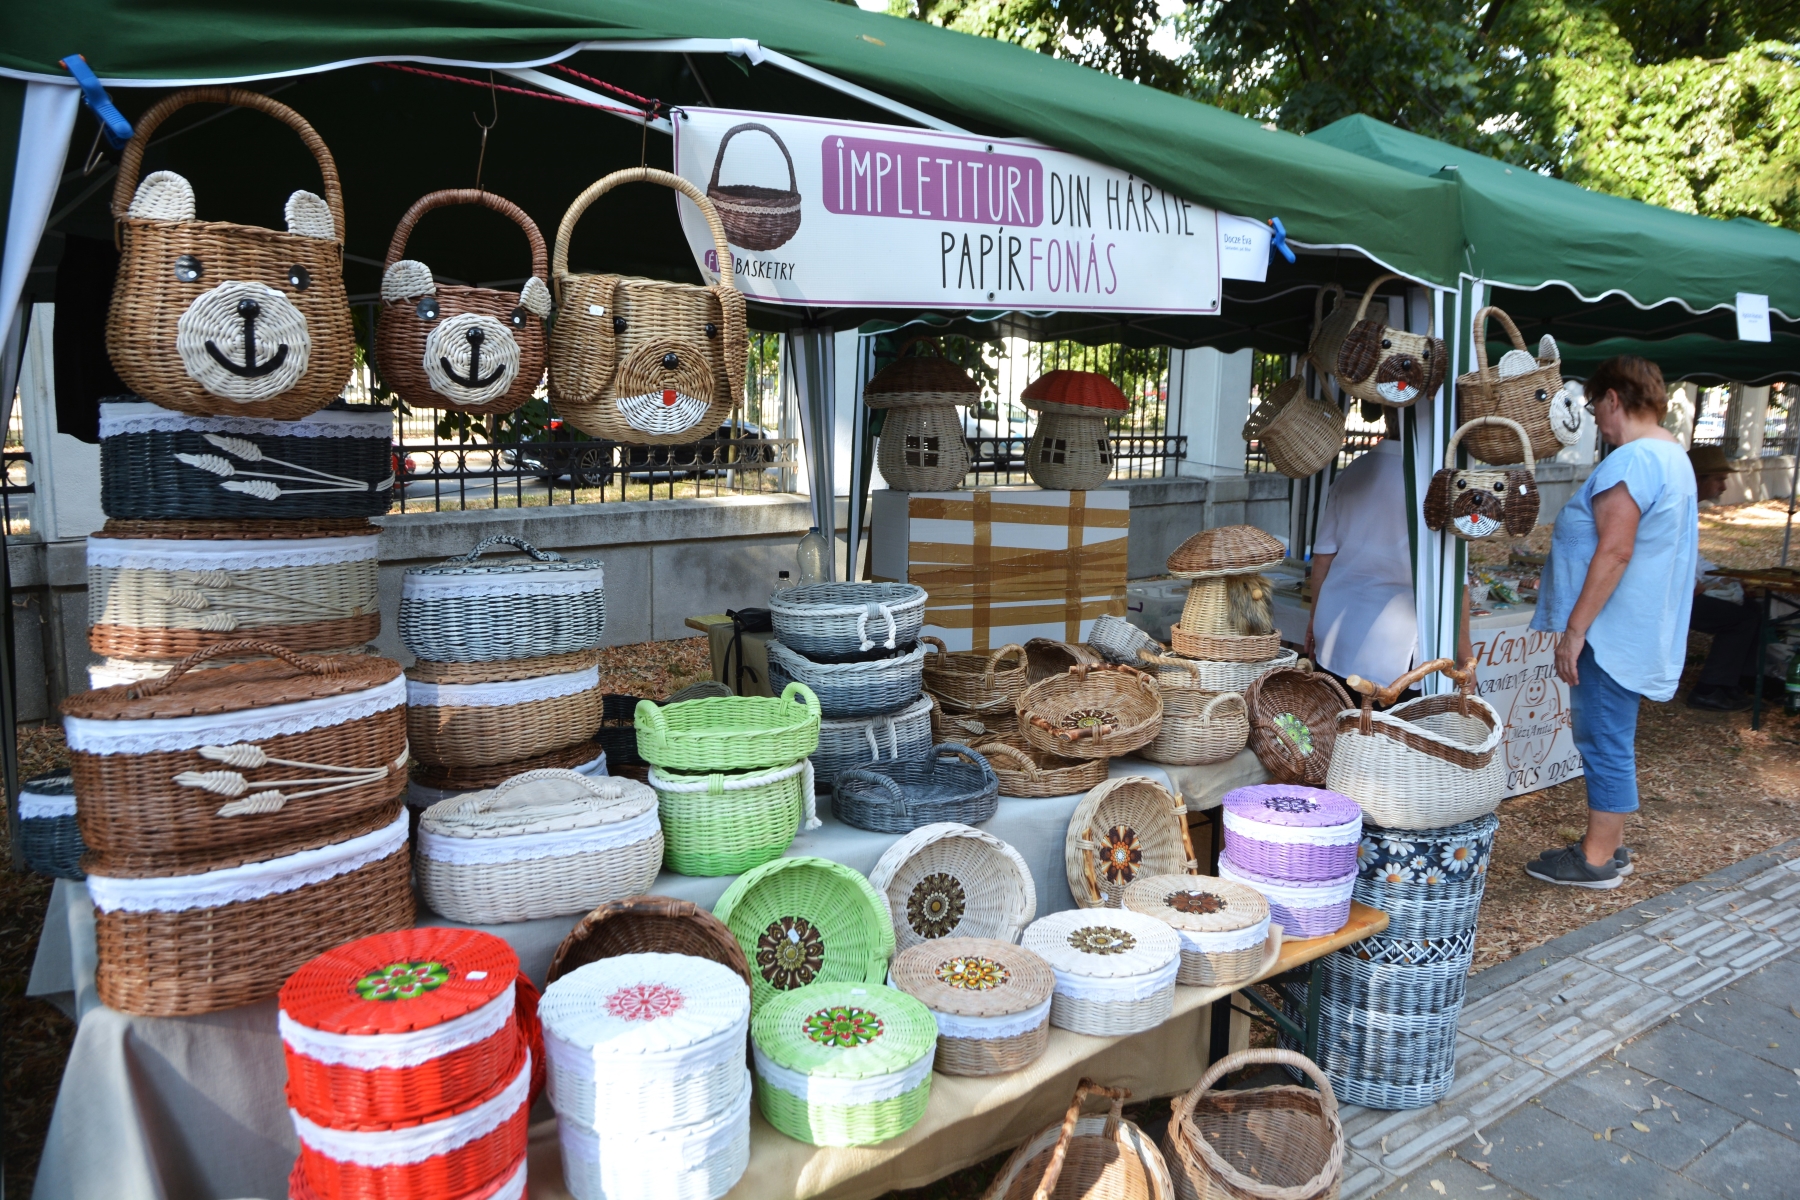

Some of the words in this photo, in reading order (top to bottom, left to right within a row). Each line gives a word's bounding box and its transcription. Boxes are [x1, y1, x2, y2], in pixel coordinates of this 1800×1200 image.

[836, 137, 1034, 224] ÎMPLETITURI
[1050, 171, 1092, 228] DIN
[735, 257, 795, 280] BASKETRY
[940, 226, 1118, 295] PAPÍRFONÁS
